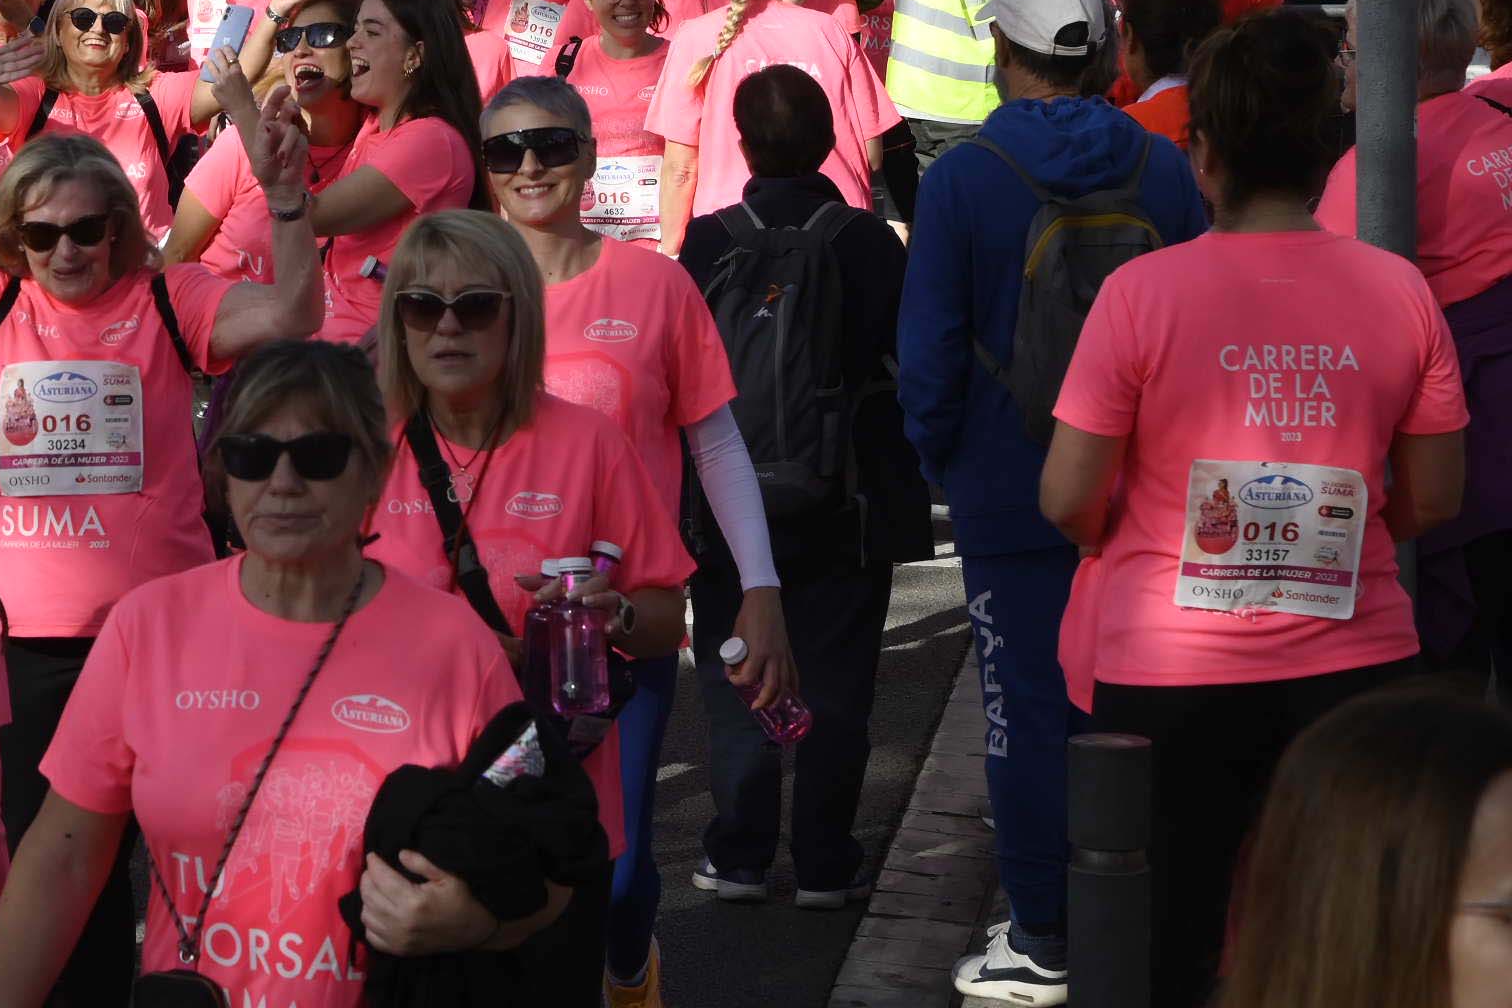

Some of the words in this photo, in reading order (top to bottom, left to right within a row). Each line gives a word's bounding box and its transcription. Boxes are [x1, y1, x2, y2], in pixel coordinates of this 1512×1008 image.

[529, 23, 553, 38] 016
[598, 192, 631, 206] 016
[604, 208, 626, 217] 4632
[1219, 344, 1361, 372] CARRERA
[39, 384, 93, 396] ASTURIANA
[102, 377, 131, 386] SUMA
[1249, 373, 1283, 400] DE
[1295, 373, 1332, 399] LA
[42, 413, 92, 434] 016
[1244, 401, 1338, 428] MUJER
[47, 438, 86, 452] 30234
[13, 457, 49, 467] CARRERA
[52, 457, 64, 465] DE
[65, 457, 75, 465] LA
[76, 455, 106, 465] MUJER
[110, 455, 129, 464] 2023
[9, 474, 50, 488] OYSHO
[87, 472, 133, 485] Santander
[1244, 489, 1308, 503] ASTURIANA
[1320, 486, 1356, 498] SUMA
[1, 504, 107, 537] SUMA
[1243, 521, 1300, 543] 016
[89, 540, 110, 549] 2023
[1245, 549, 1290, 562] 33157
[1200, 568, 1244, 579] CARRERA
[1246, 569, 1258, 578] DE
[1259, 569, 1271, 578] LA
[1272, 569, 1311, 580] MUJER
[1314, 572, 1338, 582] 2023
[1192, 585, 1245, 600] OYSHO
[1285, 590, 1341, 605] Santander
[175, 689, 261, 712] OYSHO
[337, 703, 406, 728] ASTURIANA
[171, 851, 226, 899] TU
